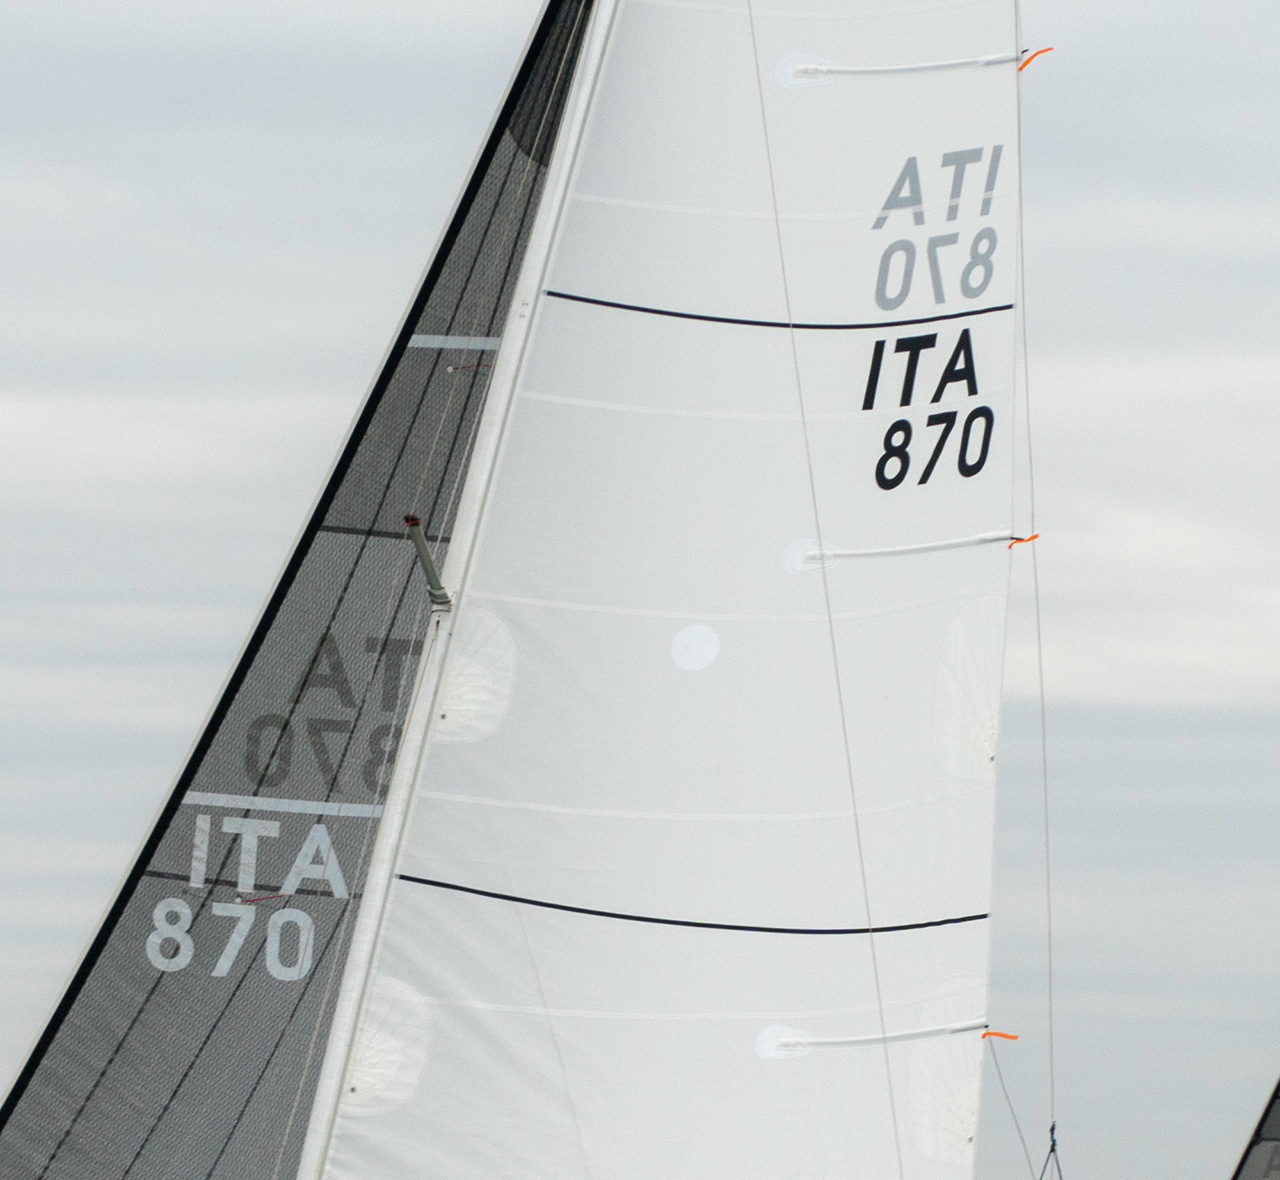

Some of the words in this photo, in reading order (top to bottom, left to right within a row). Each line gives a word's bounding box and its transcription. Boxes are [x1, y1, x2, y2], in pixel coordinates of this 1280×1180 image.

[862, 328, 979, 411] ITA
[875, 406, 995, 491] 870
[189, 814, 350, 900] ITA
[146, 897, 315, 982] 870
